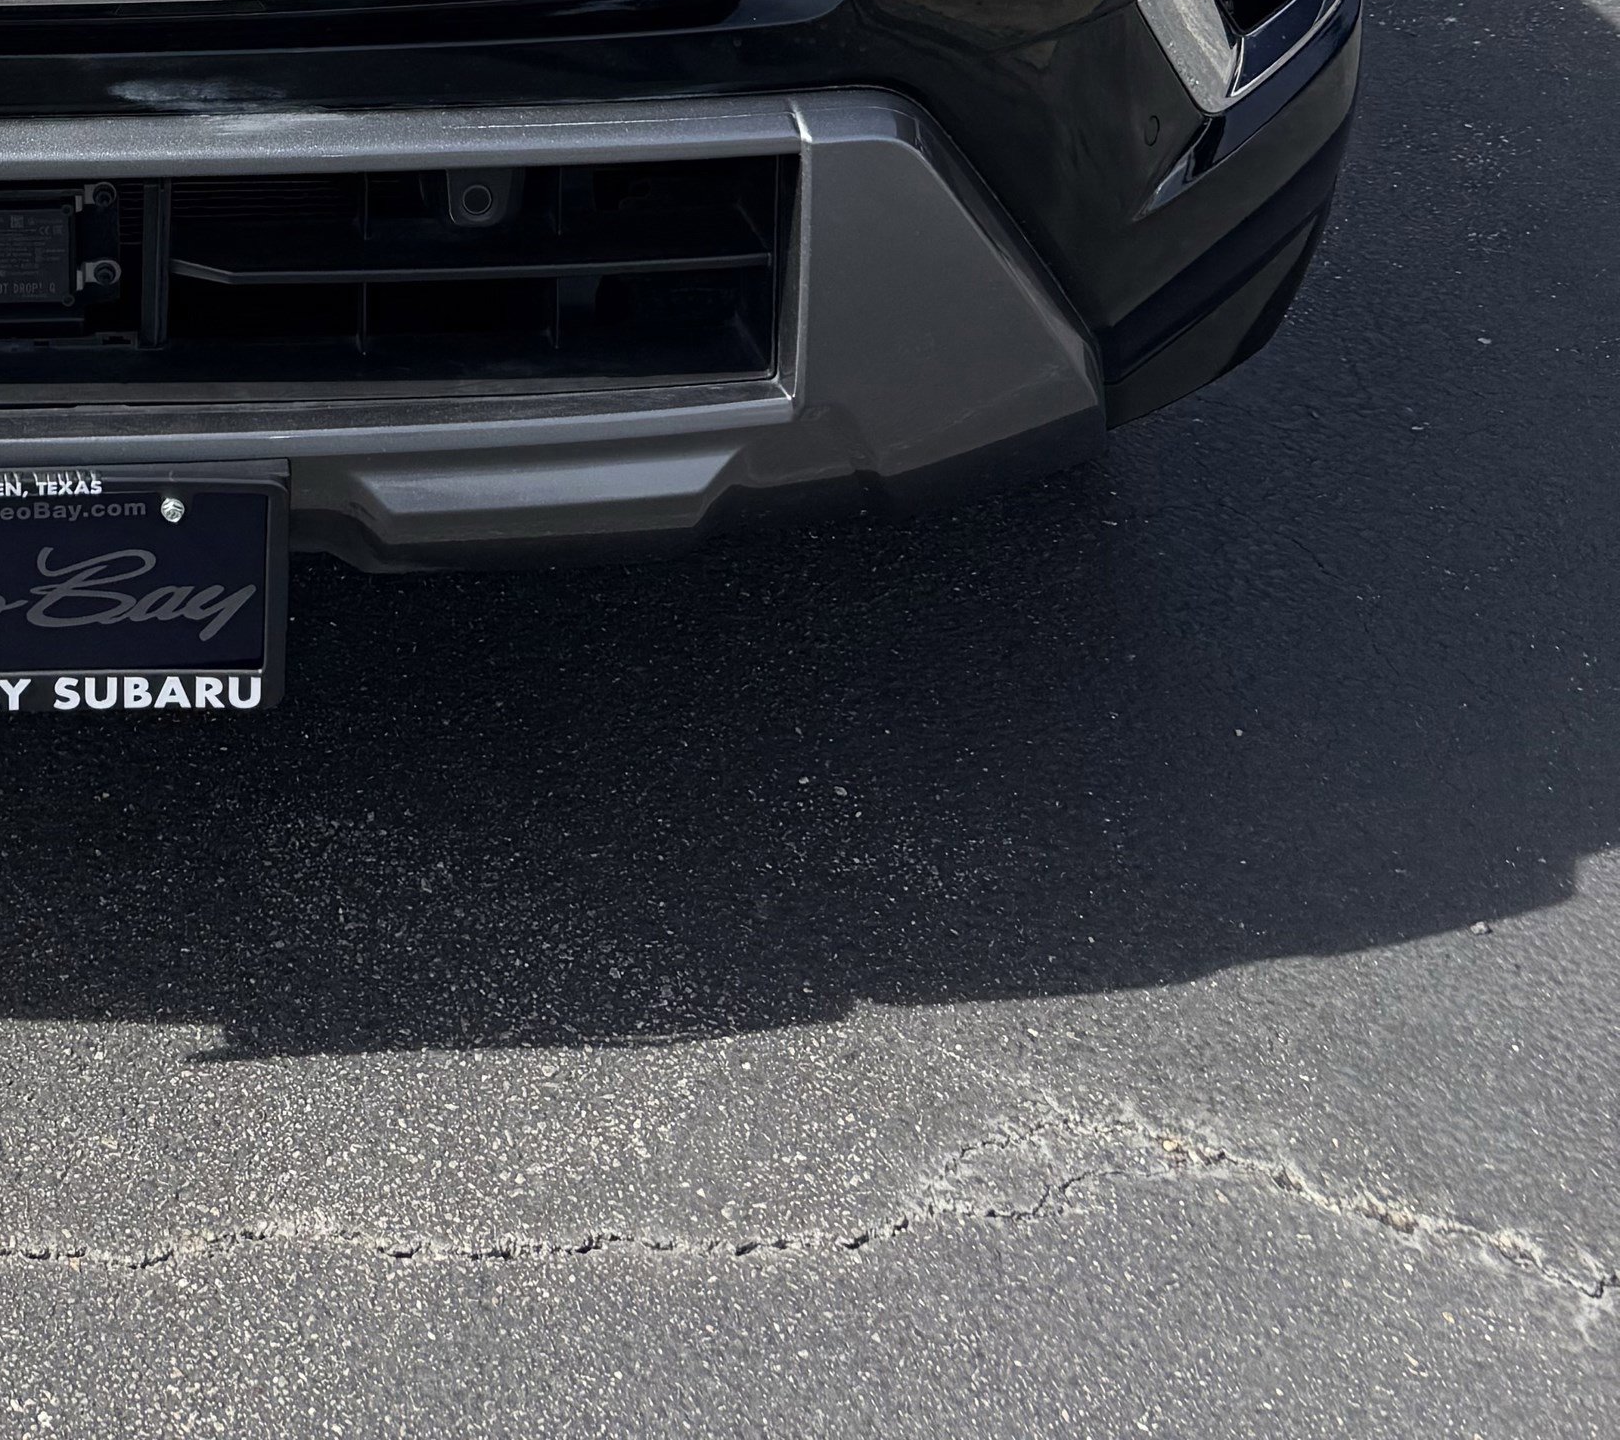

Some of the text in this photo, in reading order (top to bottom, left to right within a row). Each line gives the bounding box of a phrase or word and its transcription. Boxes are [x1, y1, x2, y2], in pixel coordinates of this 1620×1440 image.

[36, 480, 103, 496] TEXAS
[29, 547, 257, 642] Bay
[53, 676, 262, 712] SUBARU
